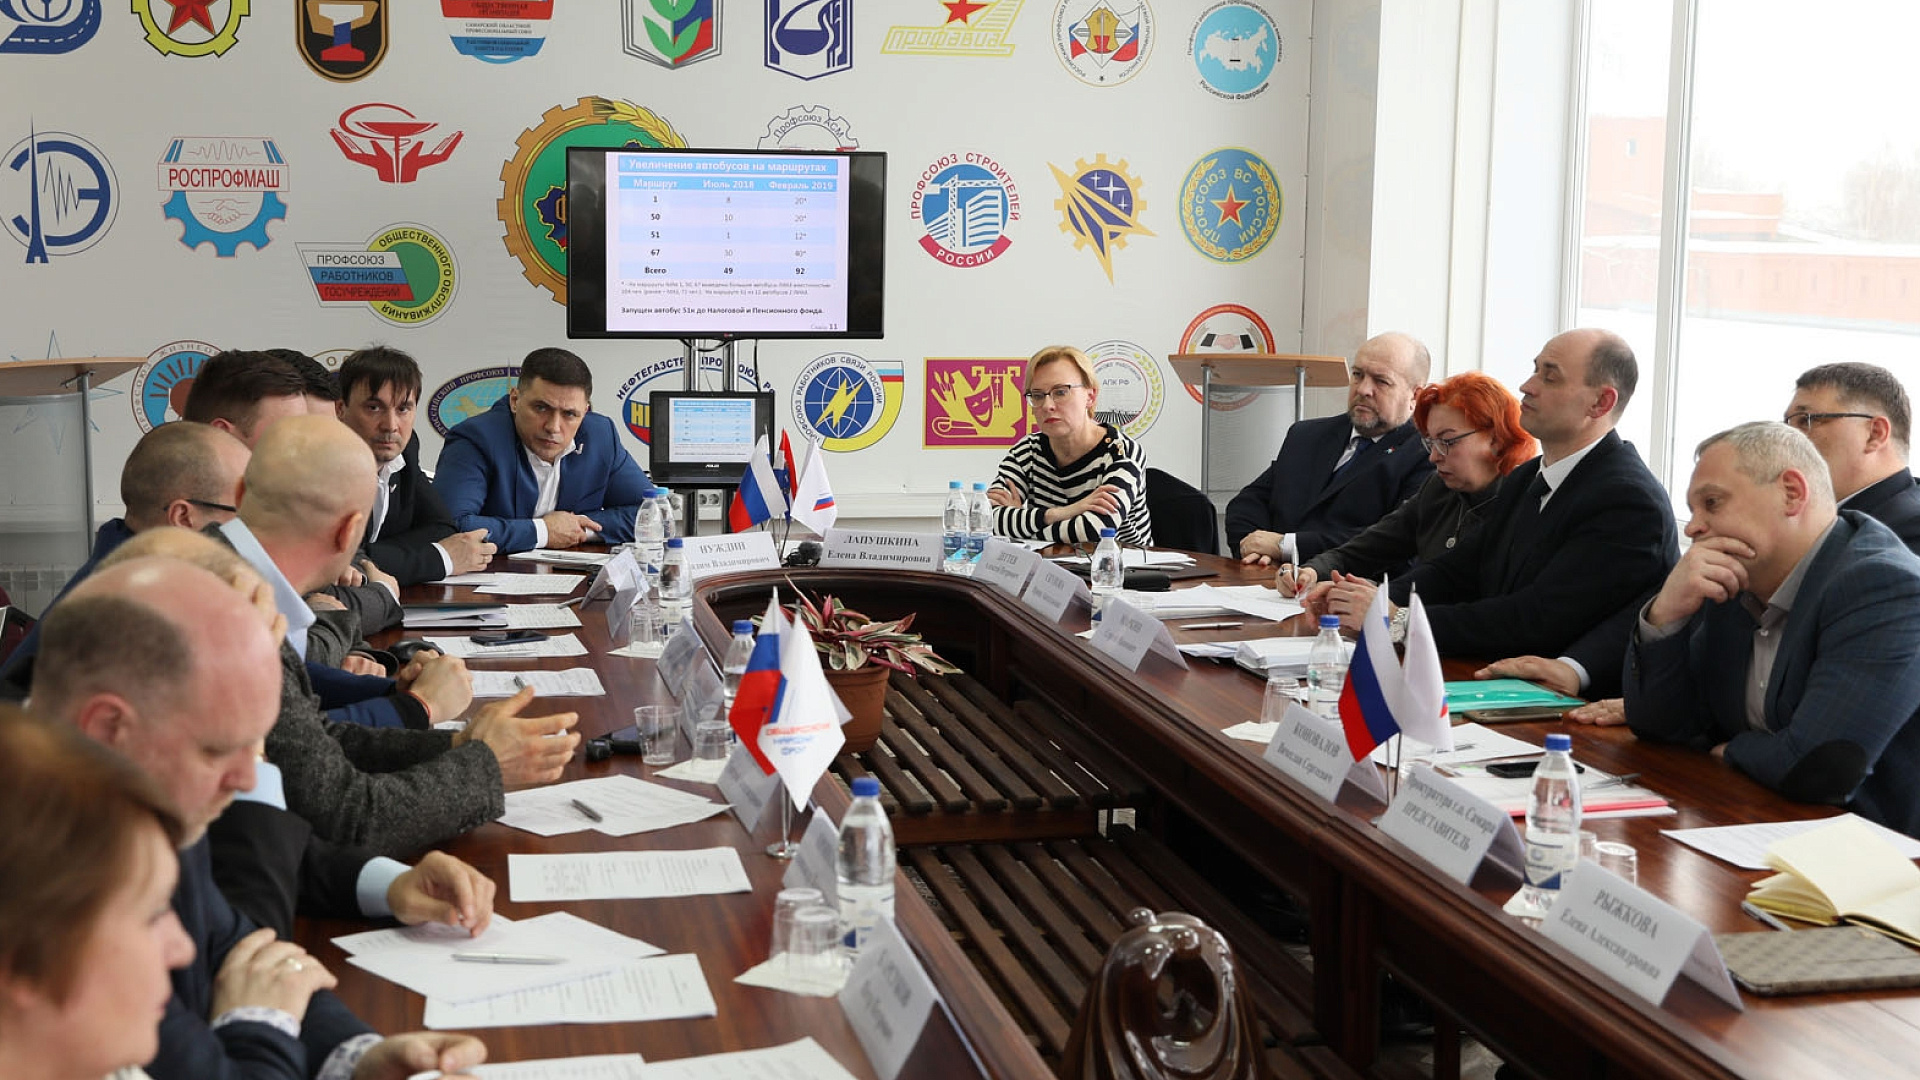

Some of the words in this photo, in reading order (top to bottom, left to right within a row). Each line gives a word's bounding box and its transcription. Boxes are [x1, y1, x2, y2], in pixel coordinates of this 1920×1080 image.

[773, 114, 823, 139] Профсоюз
[823, 119, 845, 138] АСМ
[629, 159, 693, 171] Увеличение
[695, 160, 750, 173] автобусов
[752, 163, 765, 171] на
[768, 163, 826, 174] маршрутах
[168, 168, 281, 190] РОСПРОФМАШ
[1233, 168, 1252, 184] ВС
[633, 179, 678, 189] Маршрут
[703, 180, 730, 189] Июль
[733, 180, 754, 188] 2018
[769, 181, 809, 190] Февраль
[811, 181, 833, 190] 2019
[910, 153, 958, 220] ПРОФСОЮЗ
[965, 152, 1020, 221] СТРОИТЕЛЕЙ
[1195, 168, 1227, 243] ПРОФСОЮЗ
[651, 213, 661, 221] 50
[1238, 185, 1267, 243] РОССИИ
[651, 231, 660, 239] 51
[316, 255, 385, 266] ПРОФСОЮЗ
[379, 230, 452, 277] ОБЩЕСТВЕННОГО
[651, 249, 660, 257] 67
[936, 249, 994, 266] РОССИИ
[320, 271, 394, 281] РАБОТНИКОВ
[644, 266, 667, 275] Всего
[723, 267, 733, 275] 49
[795, 267, 805, 275] 92
[381, 279, 452, 320] ОБСЛУЖИВАНИЯ
[460, 369, 505, 384] ПРОФСОЮЗ
[796, 356, 836, 396] РАБОТНИКОВ
[840, 356, 866, 371] СВЯЗИ
[867, 371, 883, 404] РОССИИ
[700, 541, 746, 554] НУЖДИН
[843, 535, 919, 547] ЛАПУШКИНА
[827, 551, 856, 561] Елена
[859, 552, 932, 564] Владимировна
[690, 561, 711, 571] адим
[1293, 721, 1340, 758] КОНОВАЛОВ
[1403, 801, 1471, 852] ПРЕДСТАВИТЕЛЬ
[1464, 805, 1497, 836] Самара
[1594, 888, 1659, 940] РЫЖКОВА
[1560, 908, 1588, 935] Елена
[1590, 926, 1662, 981] Александровна
